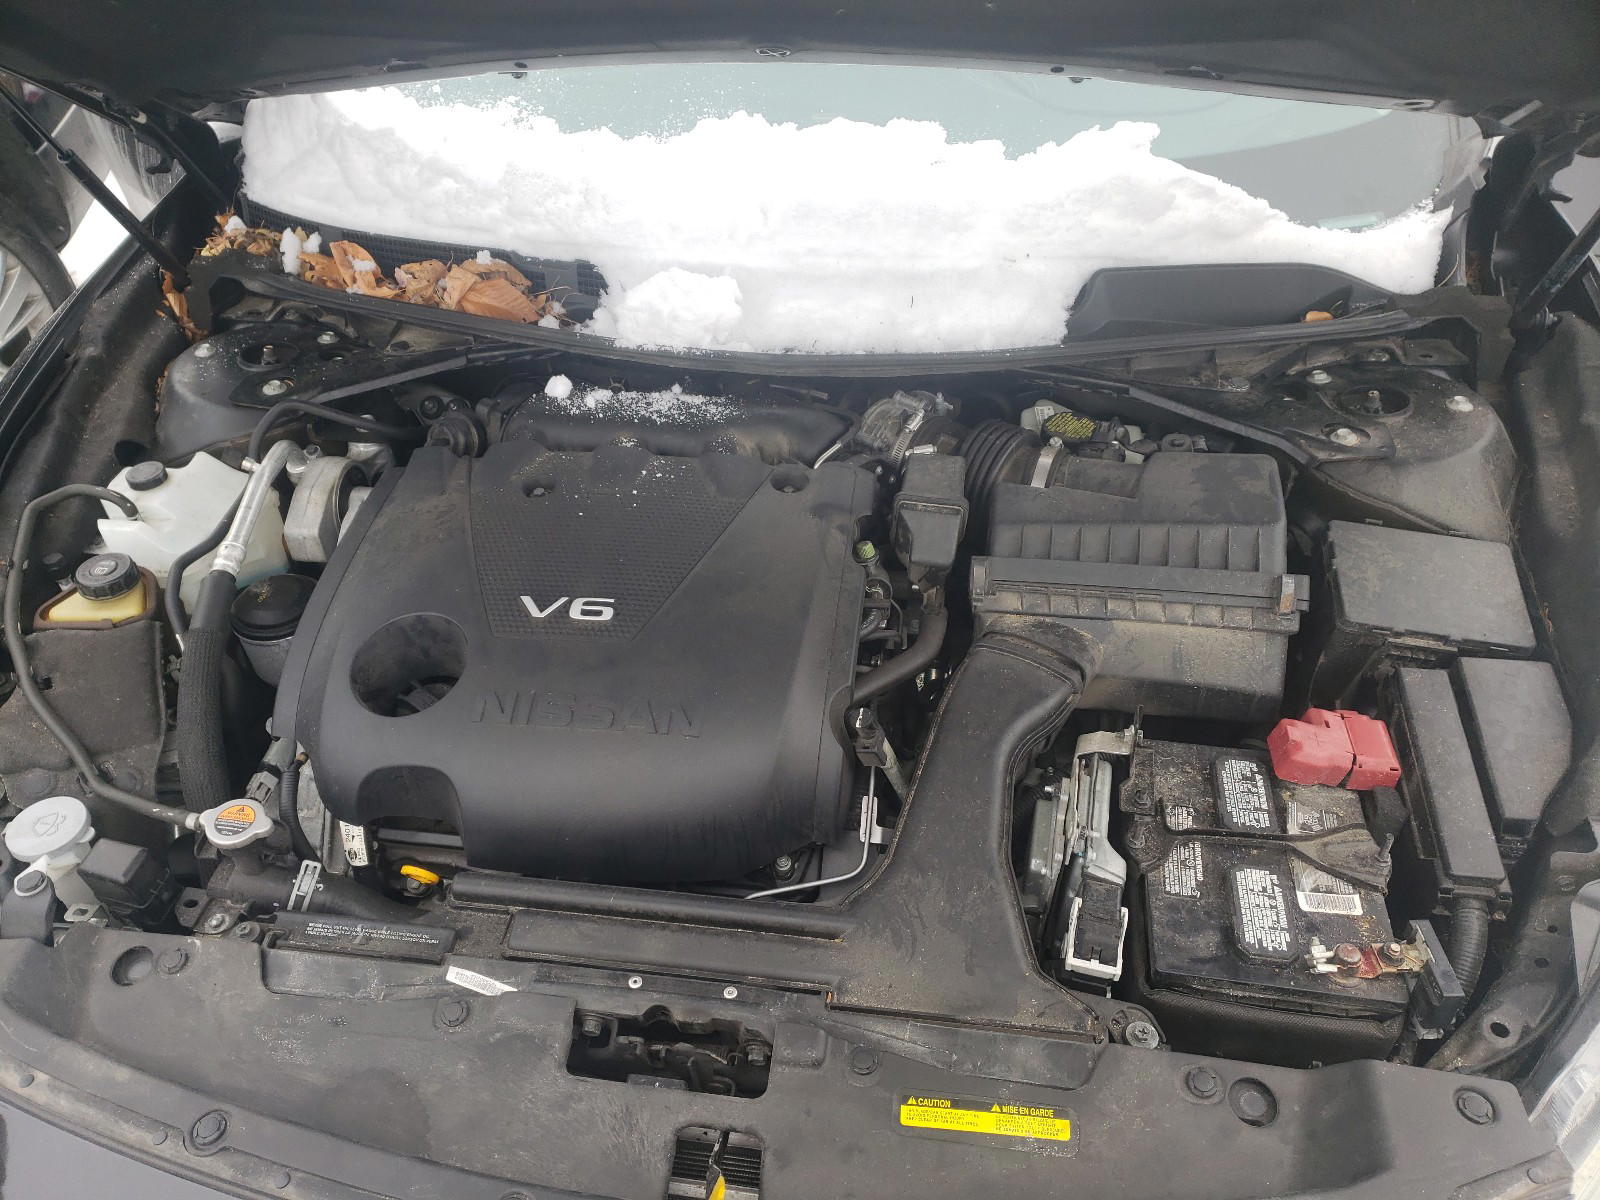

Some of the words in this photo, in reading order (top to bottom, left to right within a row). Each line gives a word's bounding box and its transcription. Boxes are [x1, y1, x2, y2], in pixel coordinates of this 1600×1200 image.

[520, 595, 615, 621] V6
[472, 690, 700, 738] NISSAN
[917, 1097, 951, 1108] CAUTION
[1001, 1105, 1019, 1114] MISE
[1019, 1107, 1029, 1115] EN
[1030, 1108, 1054, 1118] GARDE
